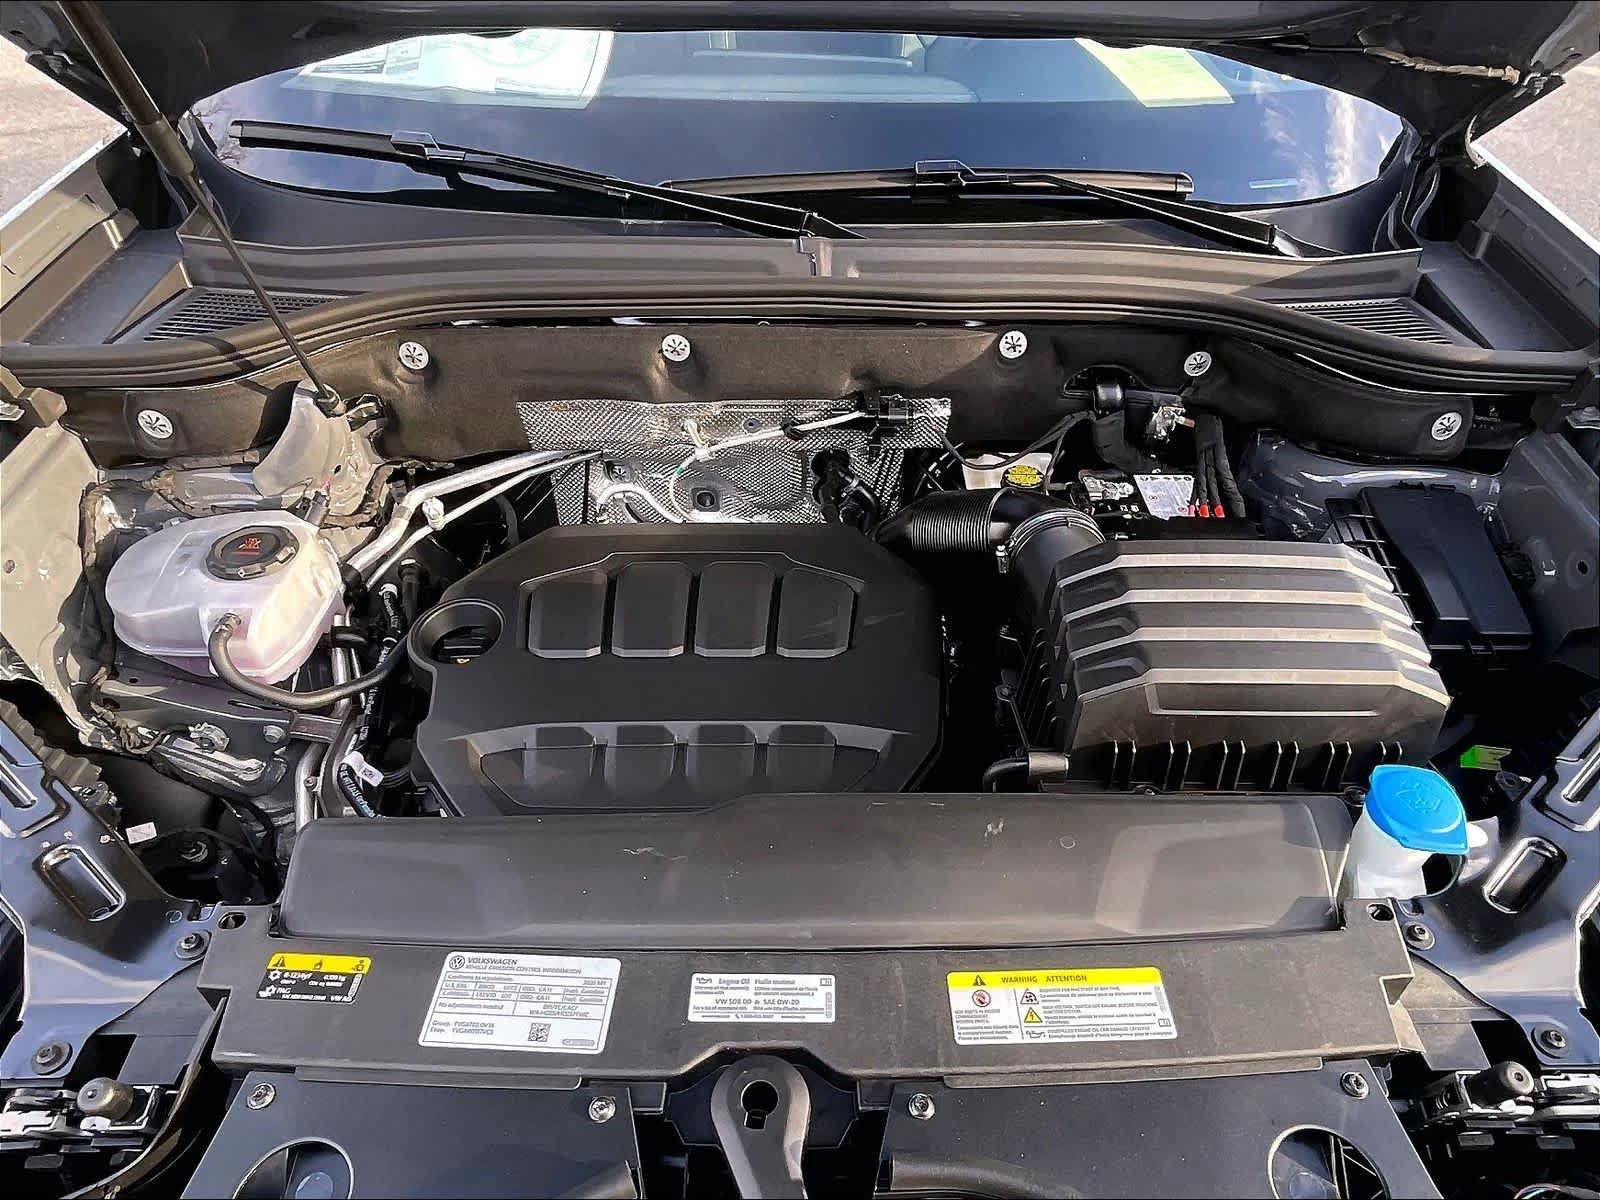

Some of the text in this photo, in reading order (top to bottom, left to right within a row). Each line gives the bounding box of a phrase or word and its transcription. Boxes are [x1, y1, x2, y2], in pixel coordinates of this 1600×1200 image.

[467, 957, 518, 966] VOLKSWAGEN
[1001, 976, 1038, 984] WARNING
[1045, 974, 1088, 983] ATTENTION
